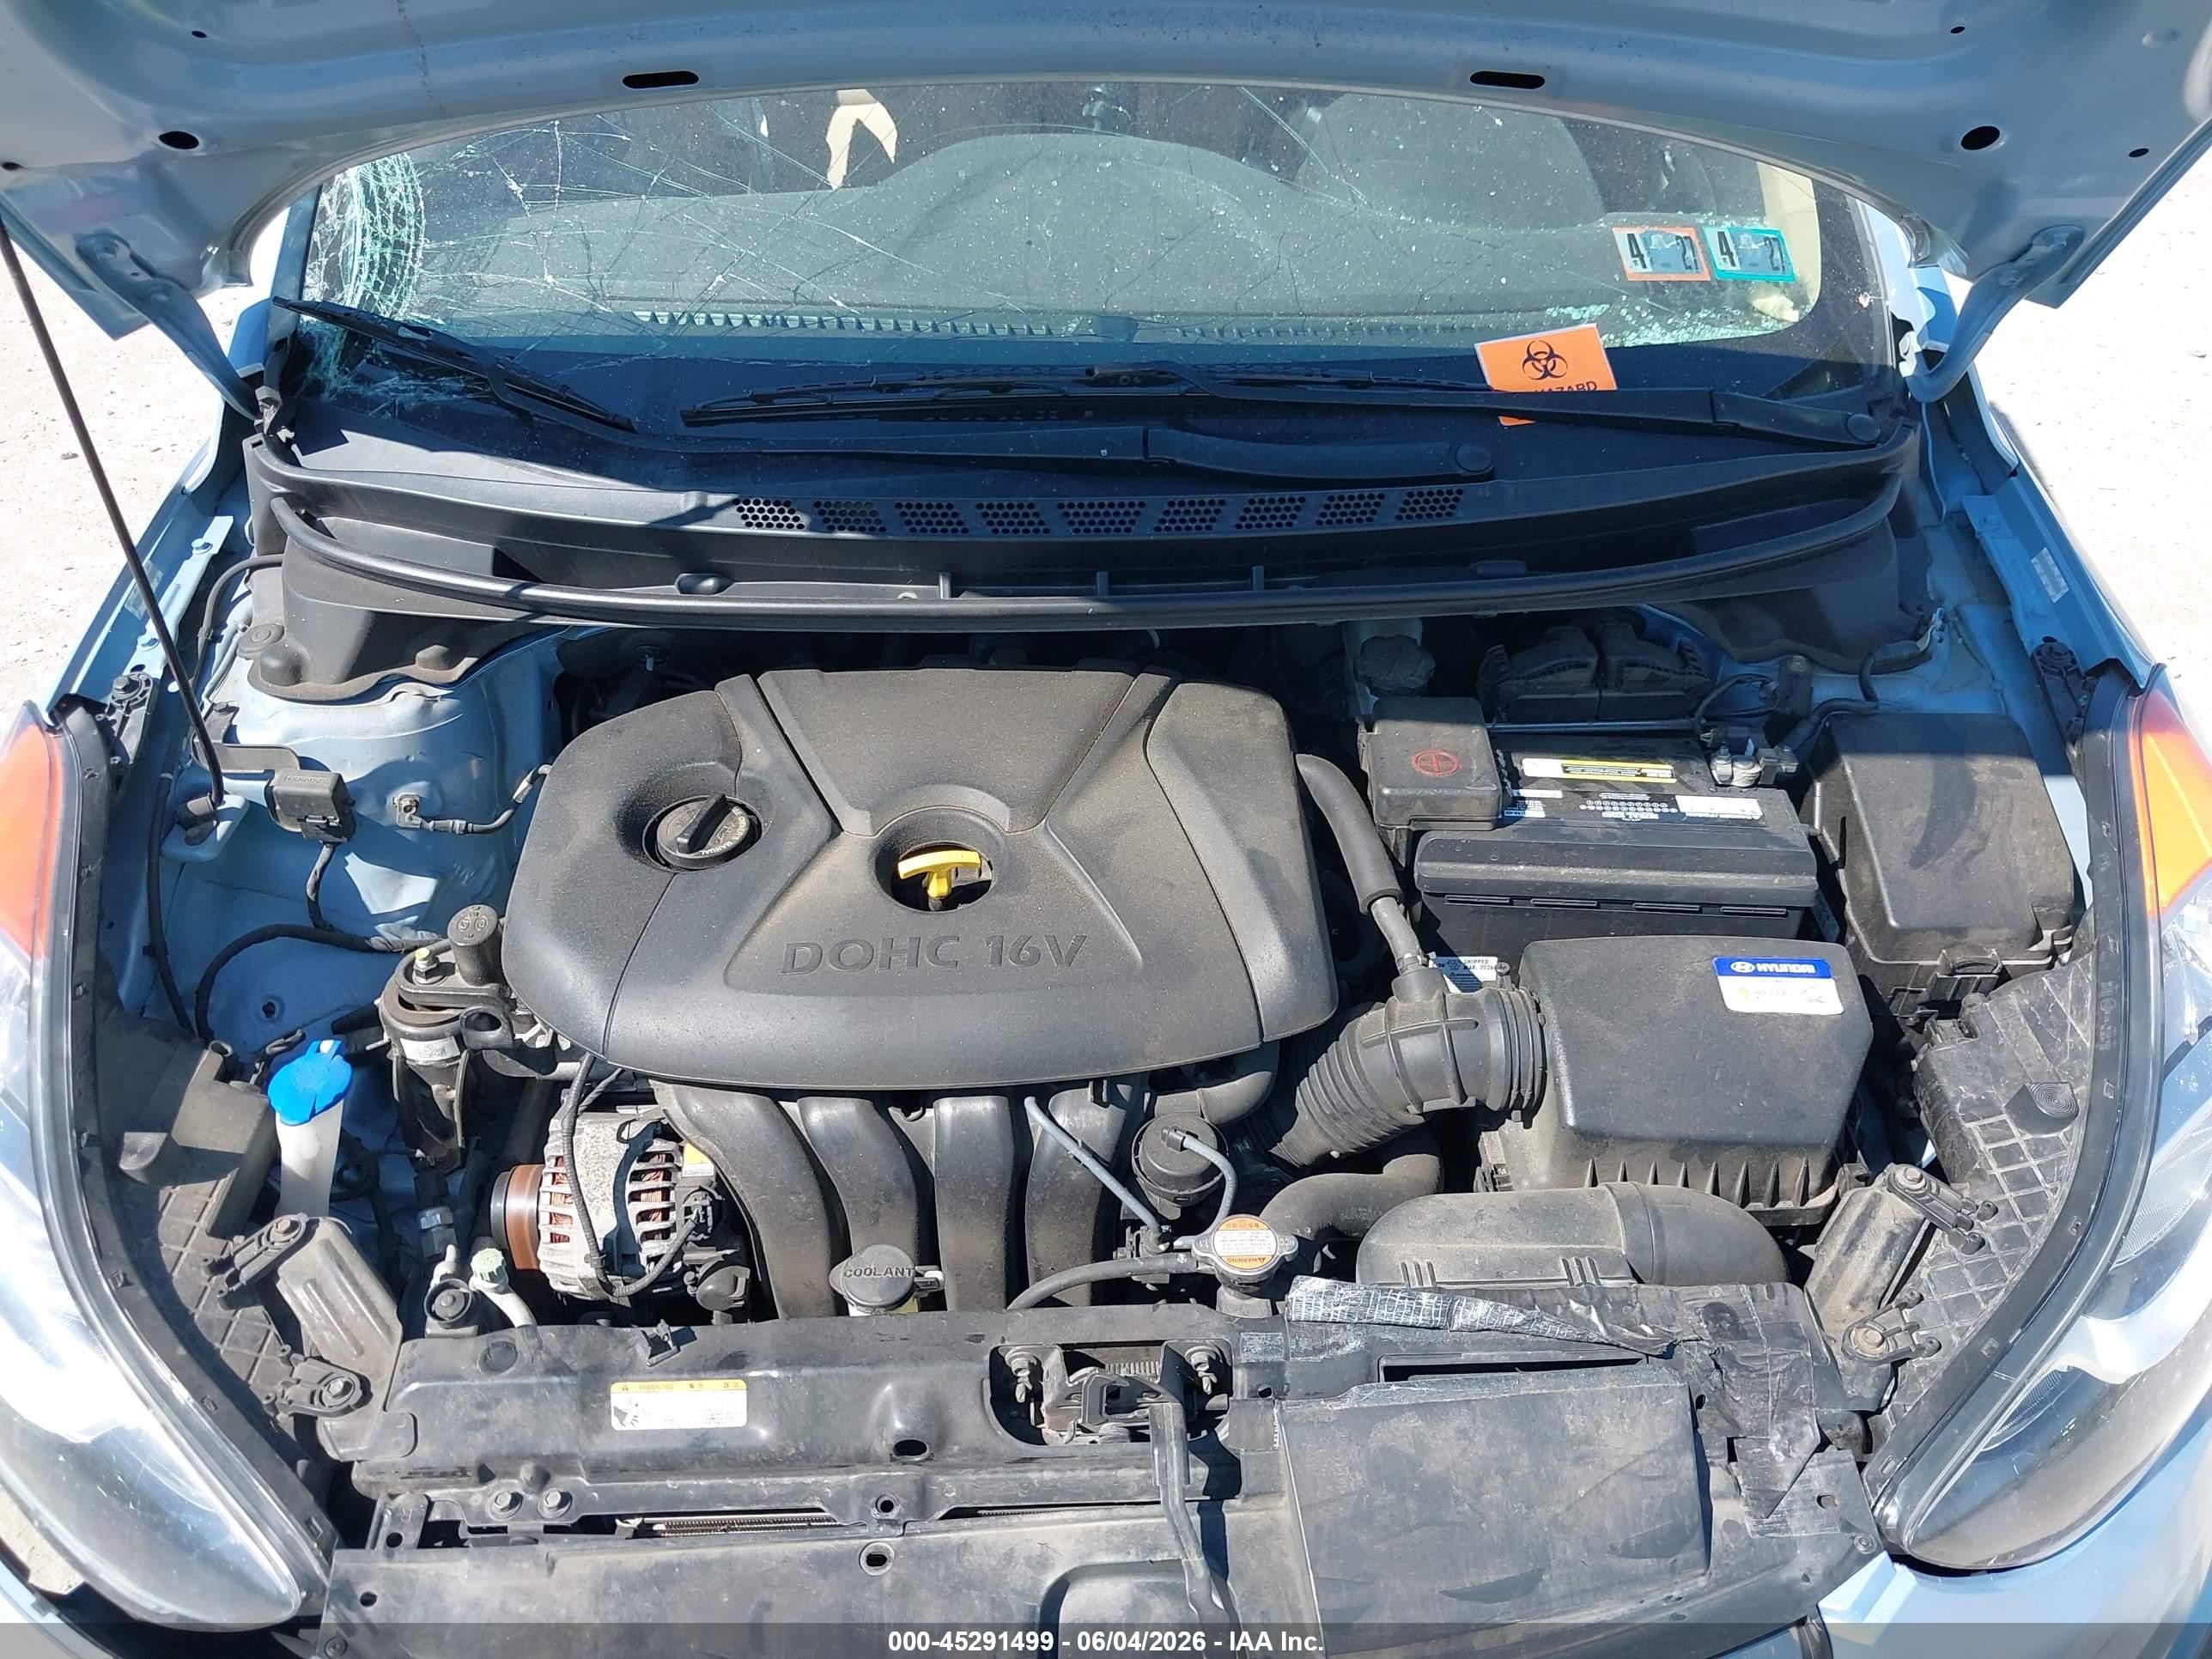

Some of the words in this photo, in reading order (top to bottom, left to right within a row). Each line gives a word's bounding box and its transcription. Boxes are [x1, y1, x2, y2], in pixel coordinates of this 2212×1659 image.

[1626, 233, 1647, 269] 4
[1676, 235, 1699, 274] 27
[1717, 231, 1736, 267] 4
[1764, 235, 1786, 274] 27
[778, 934, 962, 976] DOHC
[984, 934, 1087, 969] 16V
[1756, 963, 1817, 974] HYUNDAI
[843, 1266, 915, 1279] COOLANT
